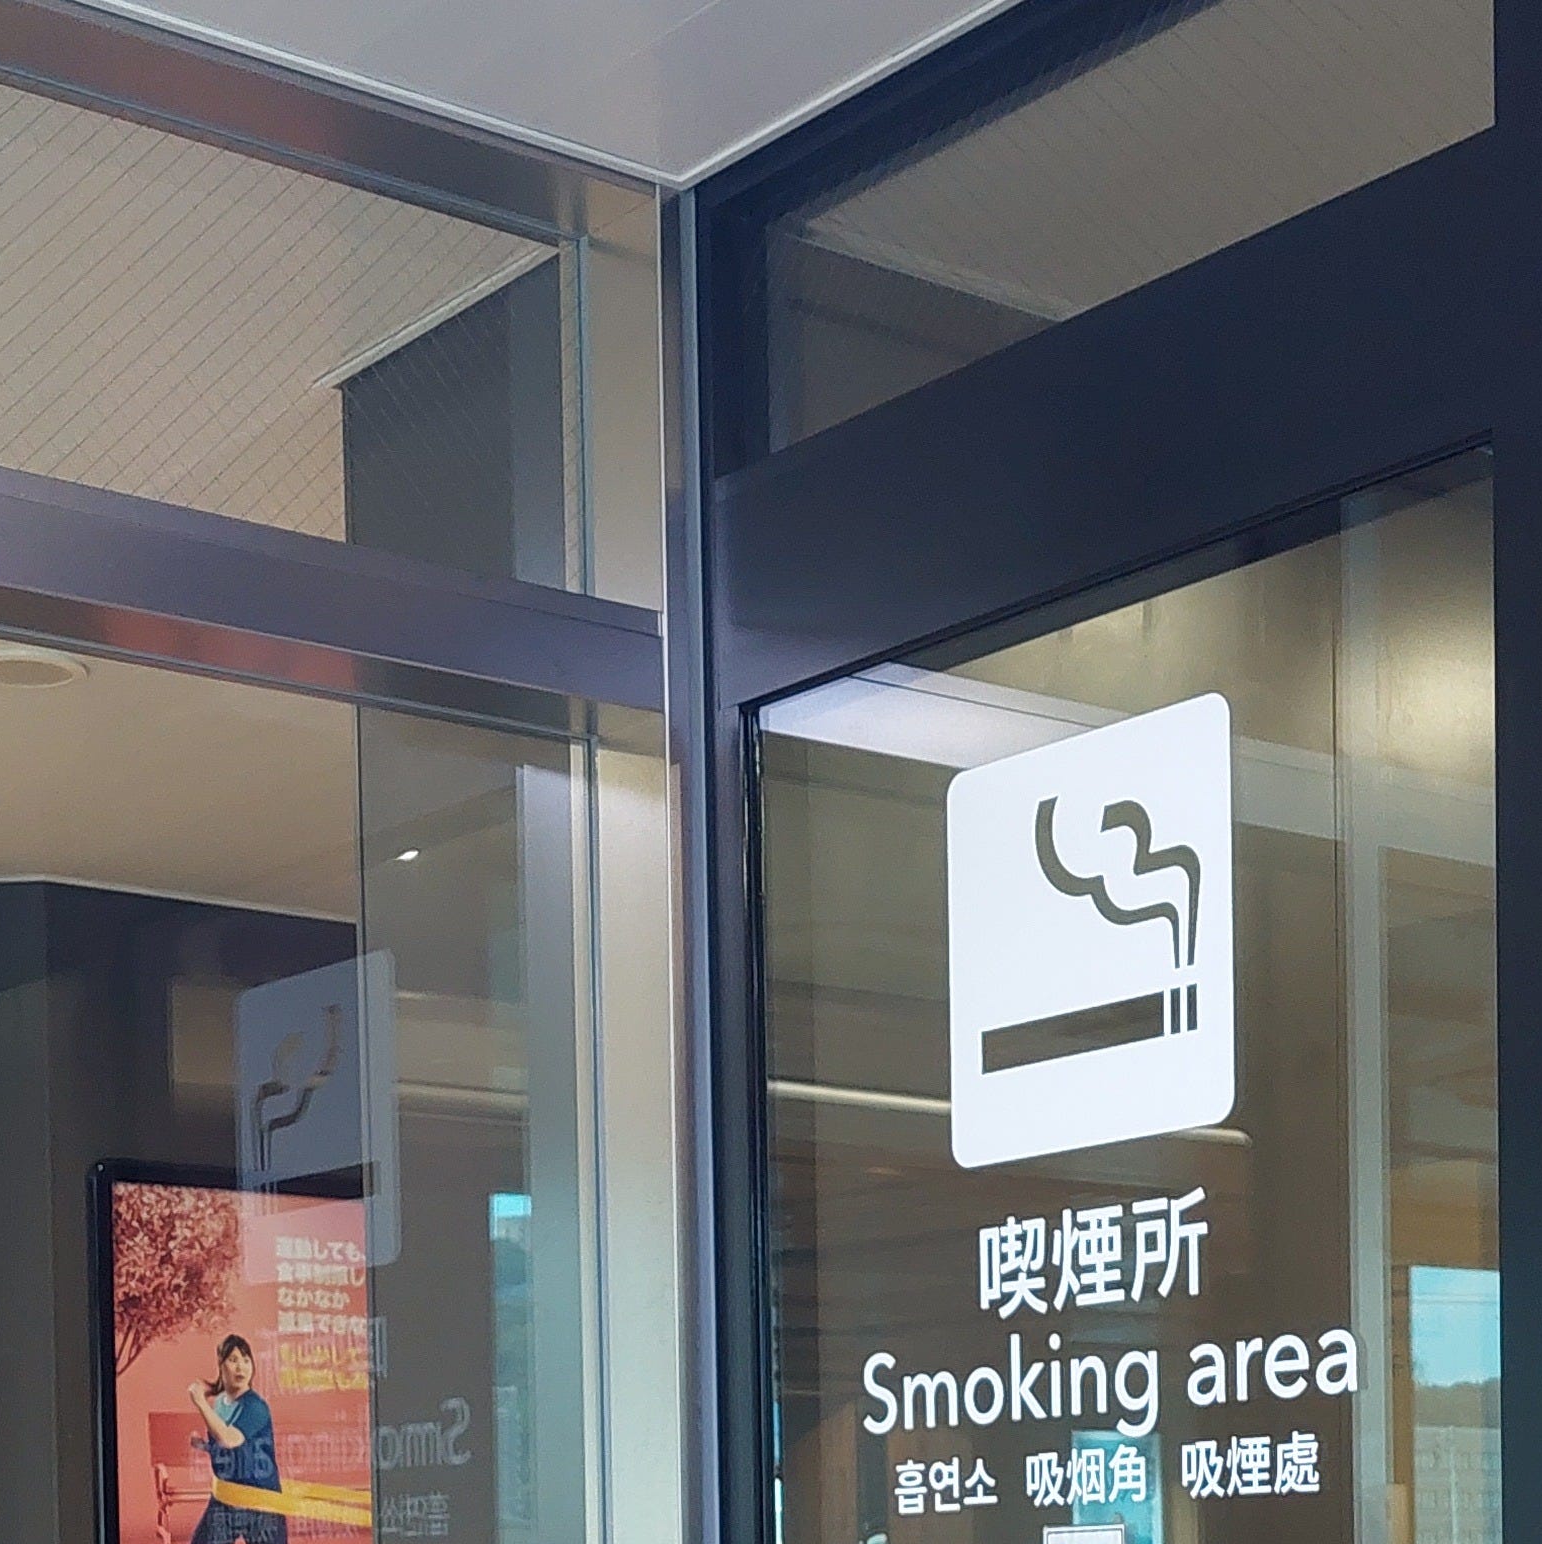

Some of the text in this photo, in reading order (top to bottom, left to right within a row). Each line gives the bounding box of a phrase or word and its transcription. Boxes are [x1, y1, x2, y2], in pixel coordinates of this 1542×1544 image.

[978, 1186, 1209, 1319] 喫煙所
[862, 1326, 1358, 1437] Smoking area
[893, 1430, 1321, 1515] 흡연소 吸烟角 吸煙處
